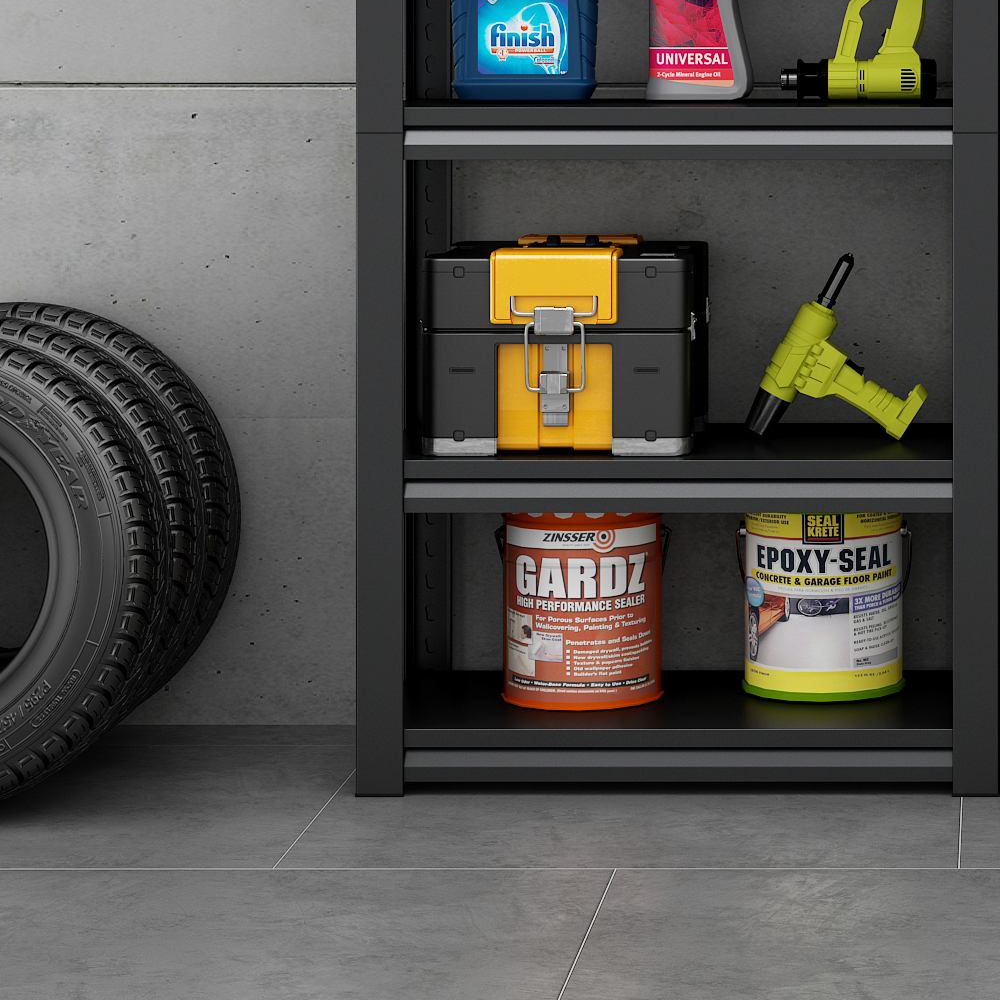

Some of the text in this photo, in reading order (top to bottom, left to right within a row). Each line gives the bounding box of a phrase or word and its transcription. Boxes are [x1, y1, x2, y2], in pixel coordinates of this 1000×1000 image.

[491, 23, 554, 47] finish
[656, 53, 728, 65] UNIVERSAL
[807, 515, 839, 527] SEAL
[543, 533, 595, 542] ZINSSER
[807, 527, 839, 537] KRETE
[757, 544, 891, 573] EPOXY-SEAL
[516, 552, 645, 599] GARDZ
[756, 571, 791, 585] CONCRETE
[804, 577, 841, 586] GARAGE
[844, 574, 870, 585] FLOOR
[872, 569, 892, 580] PAINT
[517, 594, 645, 612] HIGH PERFORMANCE SEALER
[865, 594, 881, 603] MORE
[536, 622, 581, 632] Wallcovering,
